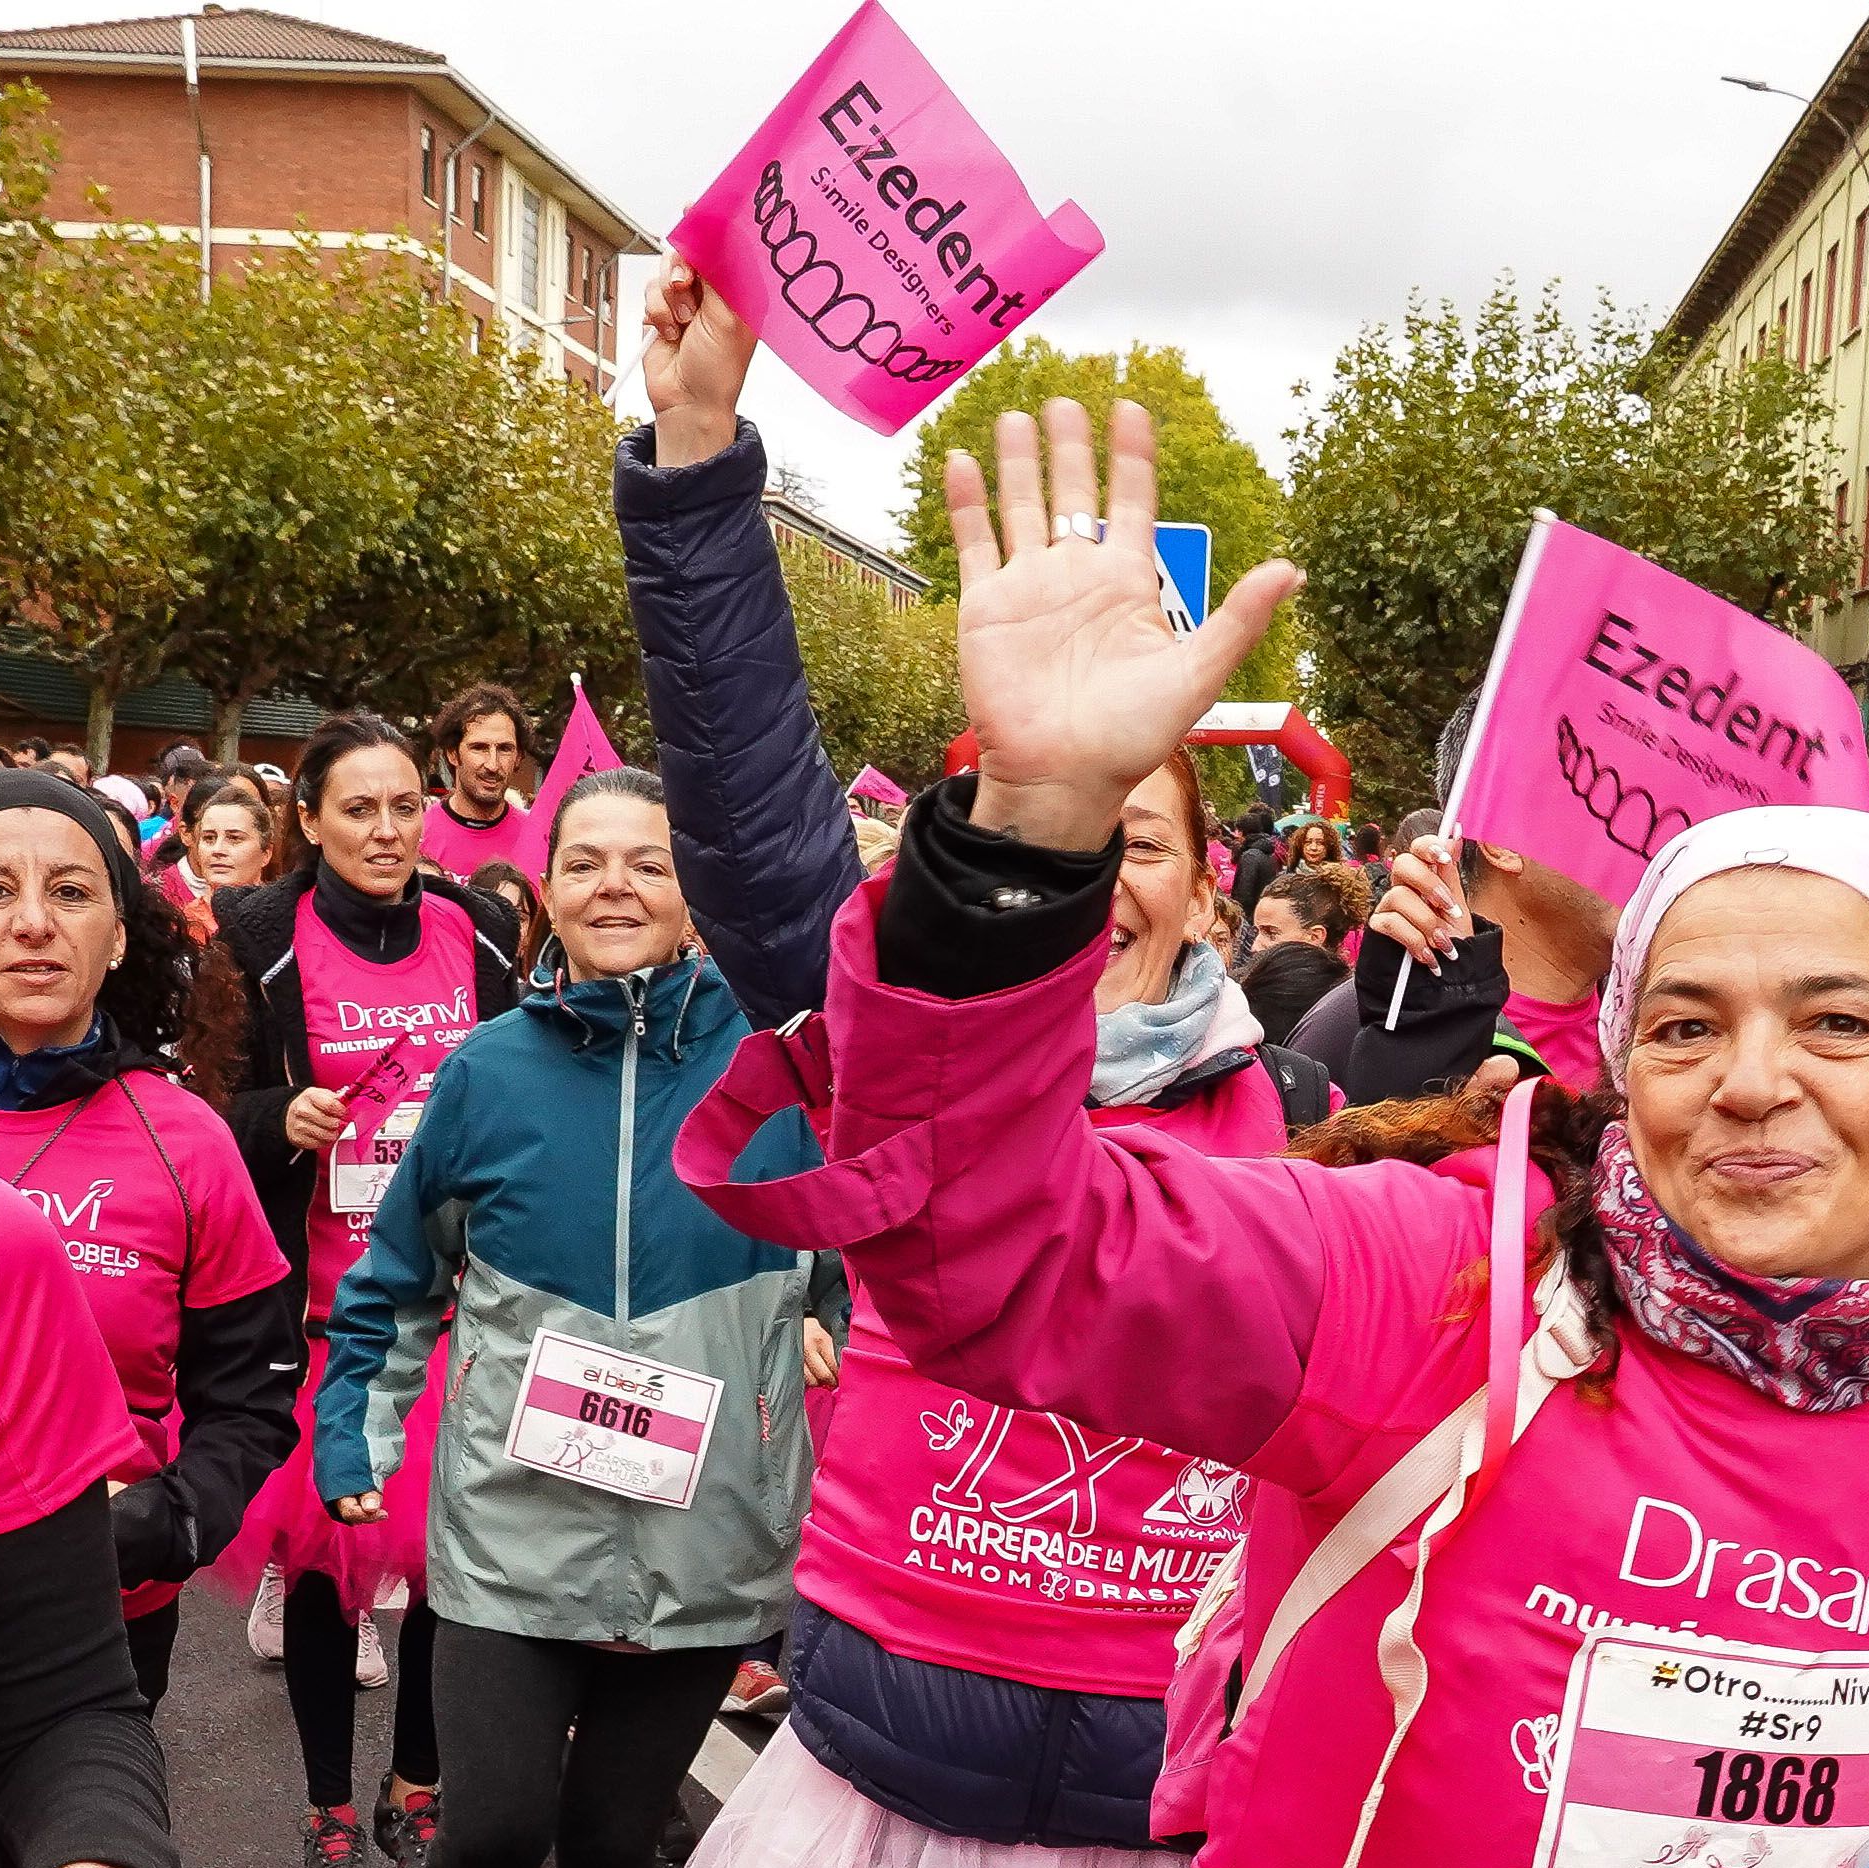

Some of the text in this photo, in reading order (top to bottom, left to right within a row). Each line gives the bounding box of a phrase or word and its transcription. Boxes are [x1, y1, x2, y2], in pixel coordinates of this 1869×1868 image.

[818, 80, 1030, 328] Ezedent
[868, 230, 957, 336] Designers
[1581, 608, 1828, 786] Ezedent
[64, 1239, 141, 1271] OBELS
[578, 1391, 654, 1439] 6616
[903, 1548, 1032, 1590] ALMOM
[909, 1505, 1065, 1570] CARRERA
[1065, 1545, 1101, 1568] DE
[1129, 1545, 1230, 1585] MUJE
[1737, 1710, 1822, 1743] #Sr9
[1693, 1750, 1840, 1826] 1868
